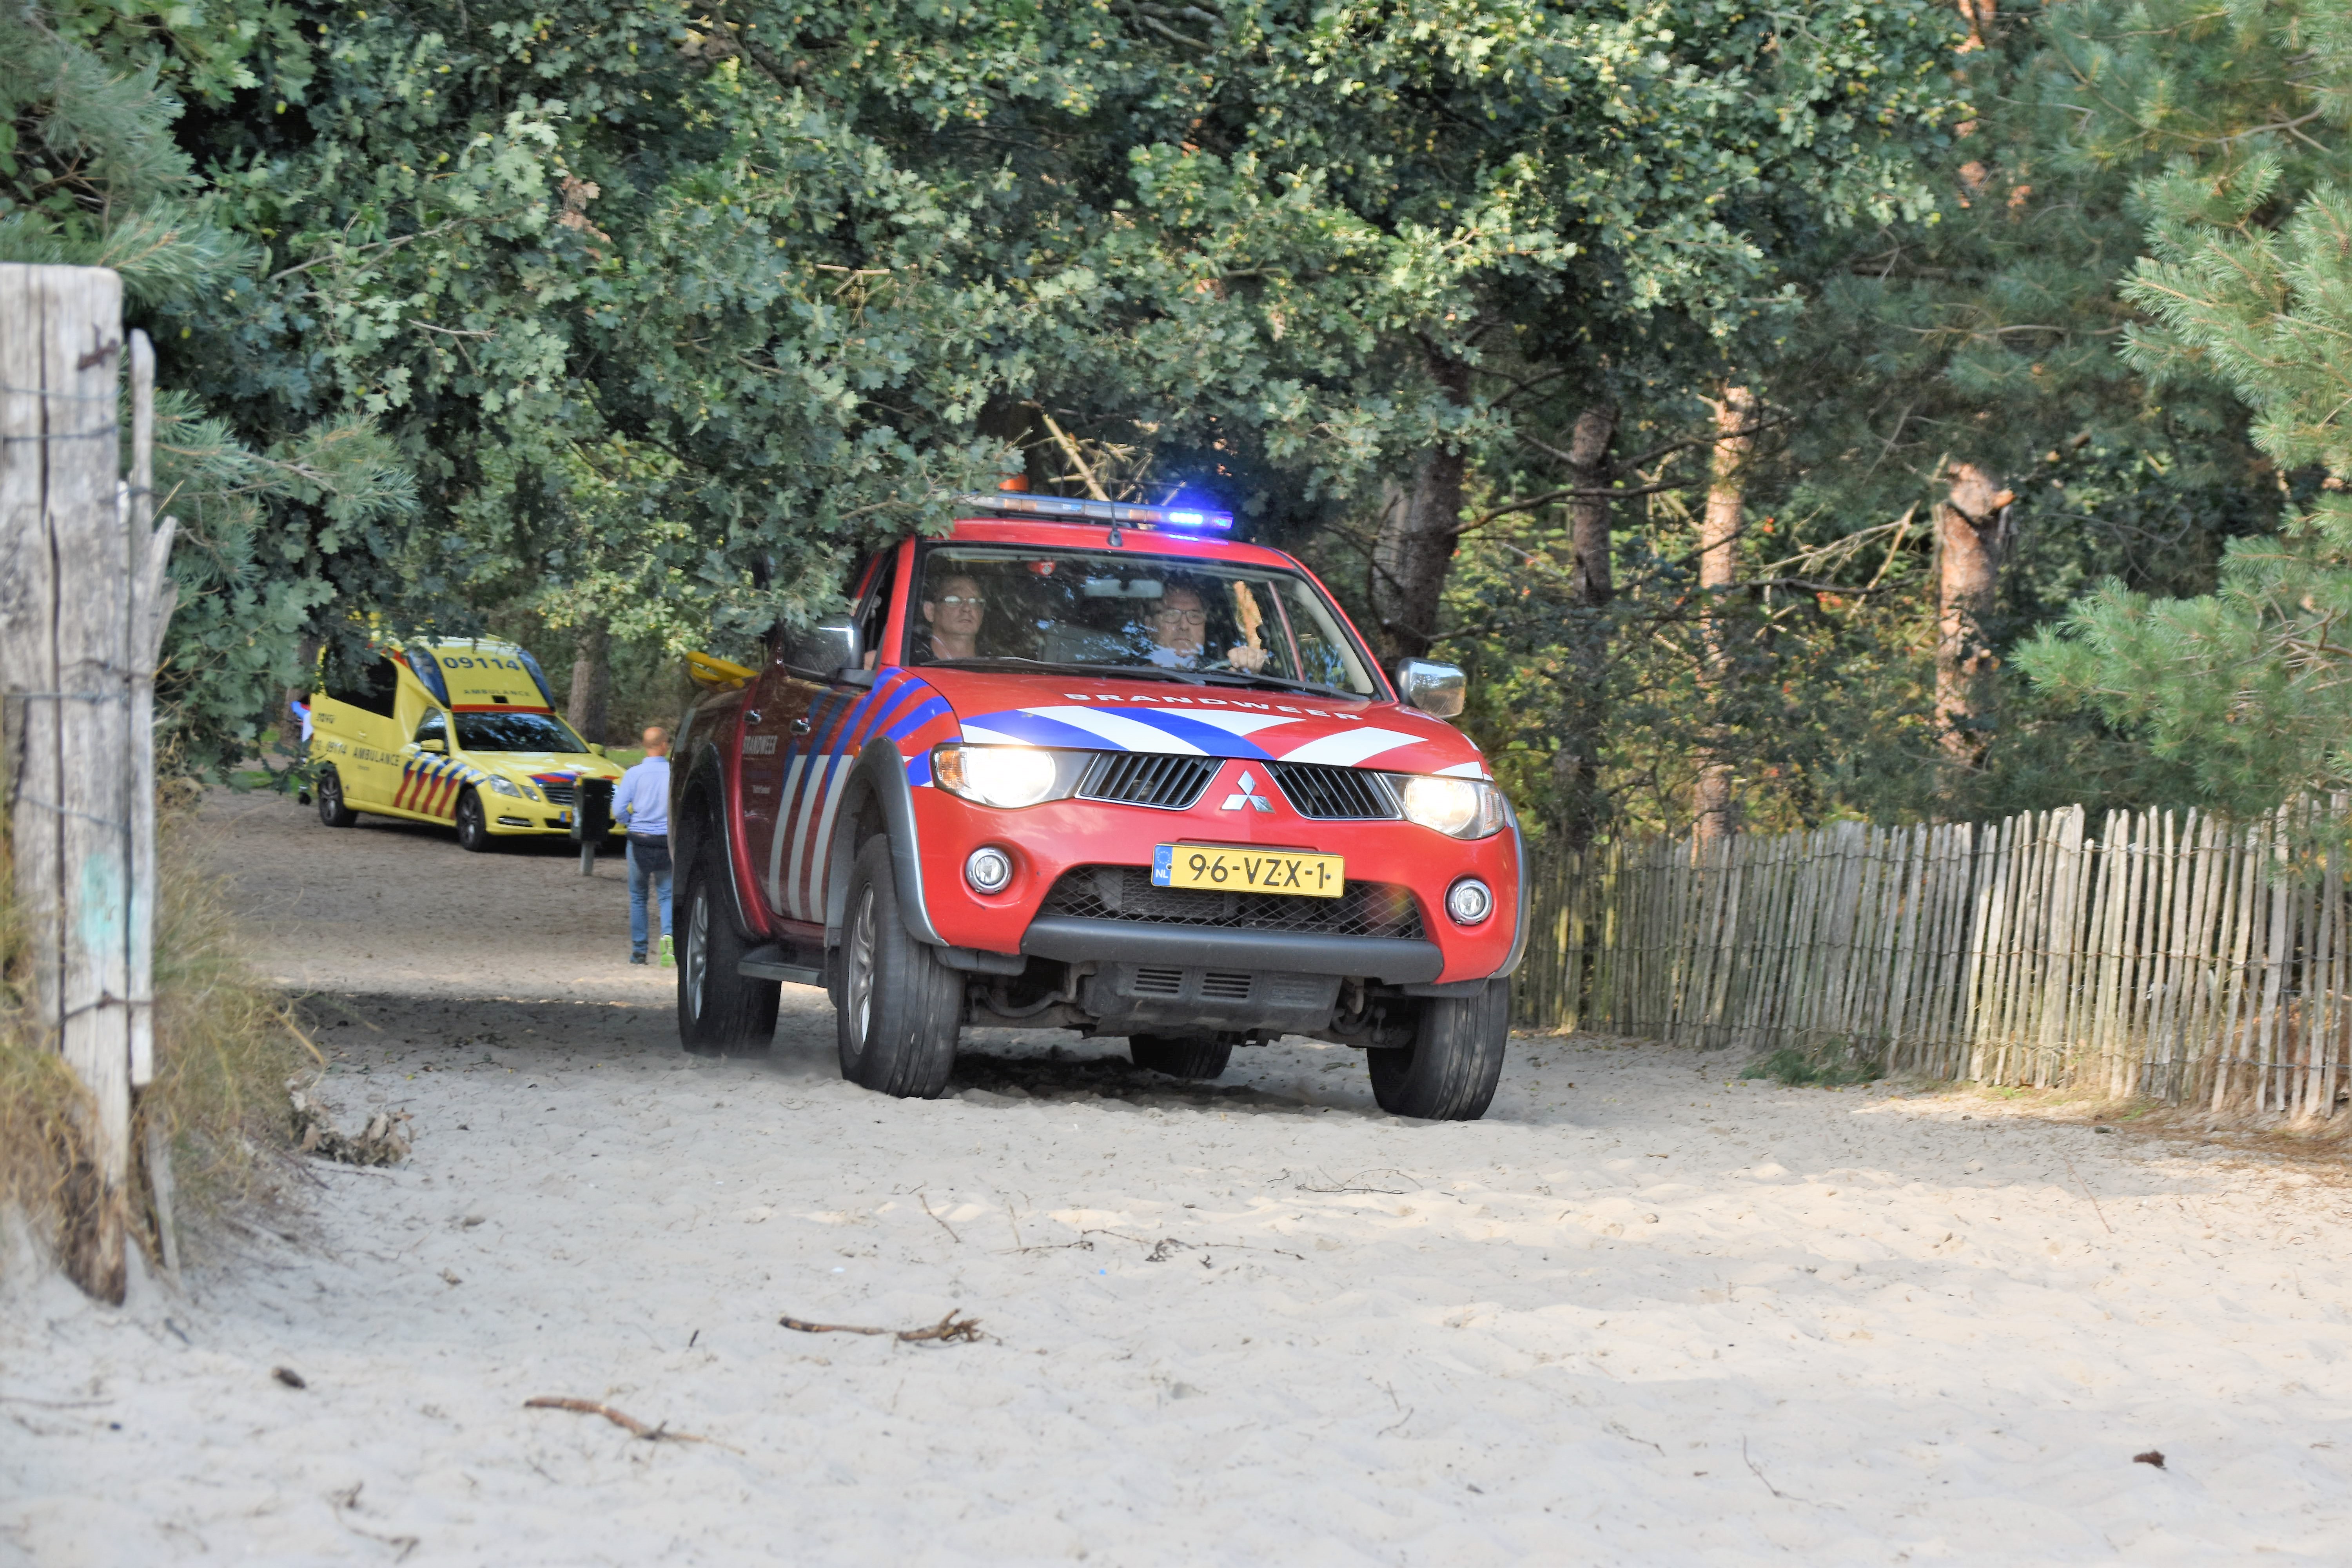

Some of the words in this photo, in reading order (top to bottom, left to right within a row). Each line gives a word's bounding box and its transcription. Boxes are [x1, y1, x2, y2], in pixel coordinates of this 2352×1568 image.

[443, 657, 520, 671] 09114
[1063, 693, 1363, 720] BRANDWEER
[354, 747, 399, 766] AMBULANCE
[1155, 869, 1168, 878] NL
